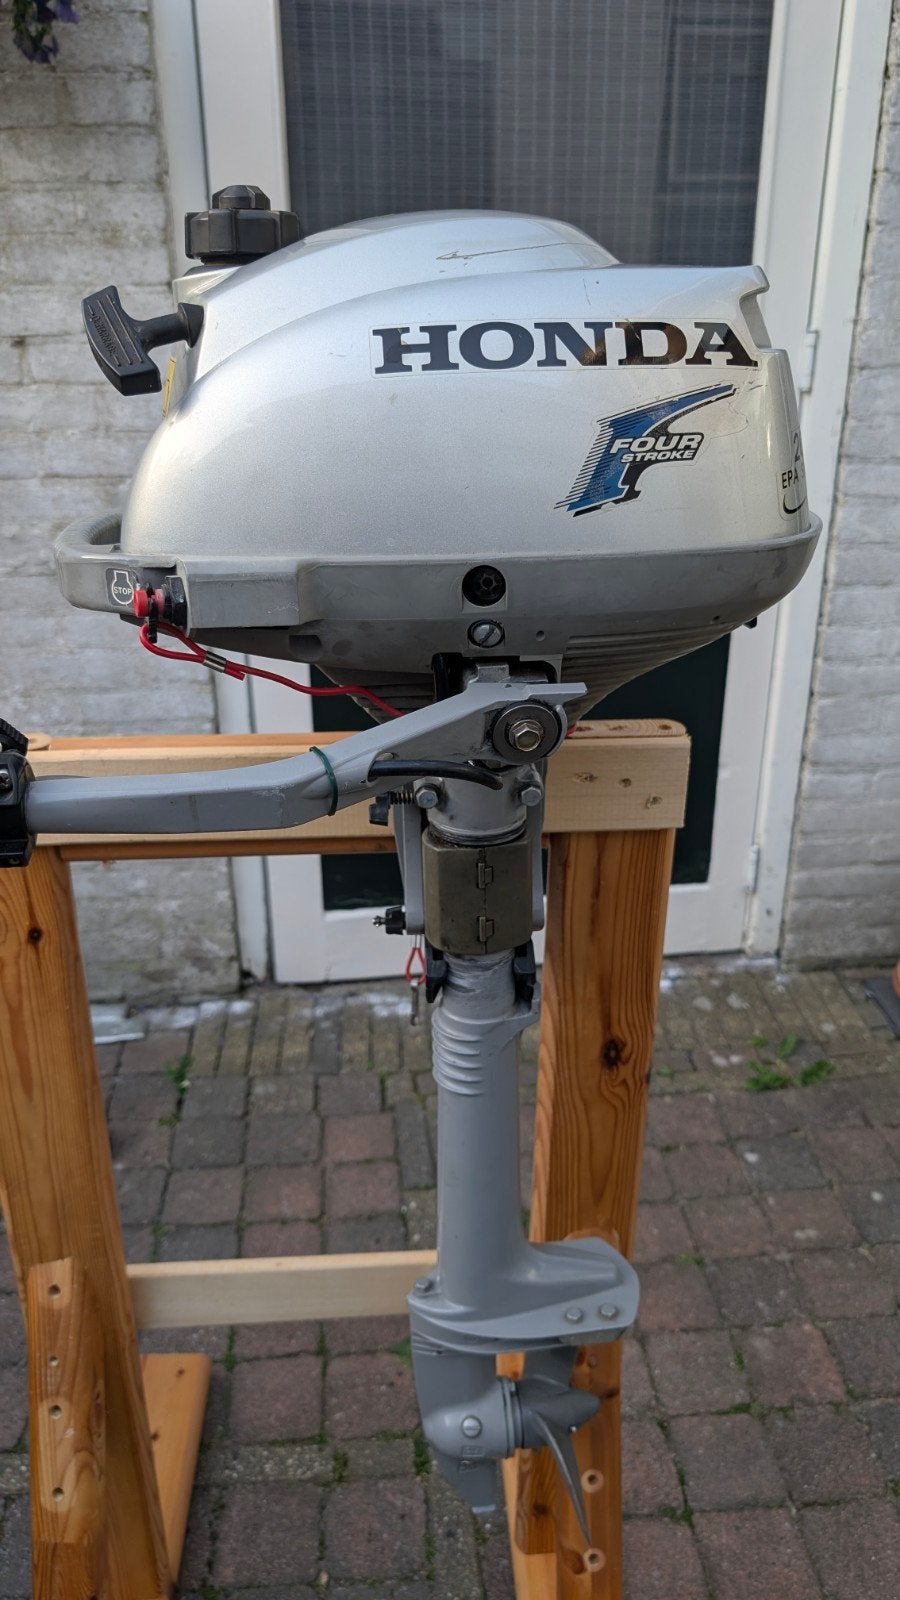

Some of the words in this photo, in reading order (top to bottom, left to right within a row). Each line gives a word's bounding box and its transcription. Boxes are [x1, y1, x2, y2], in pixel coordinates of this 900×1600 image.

[372, 321, 759, 375] HONDA
[609, 433, 702, 455] FOUR
[620, 449, 696, 463] STROKE
[781, 468, 800, 490] EPA
[113, 586, 133, 596] STOP
